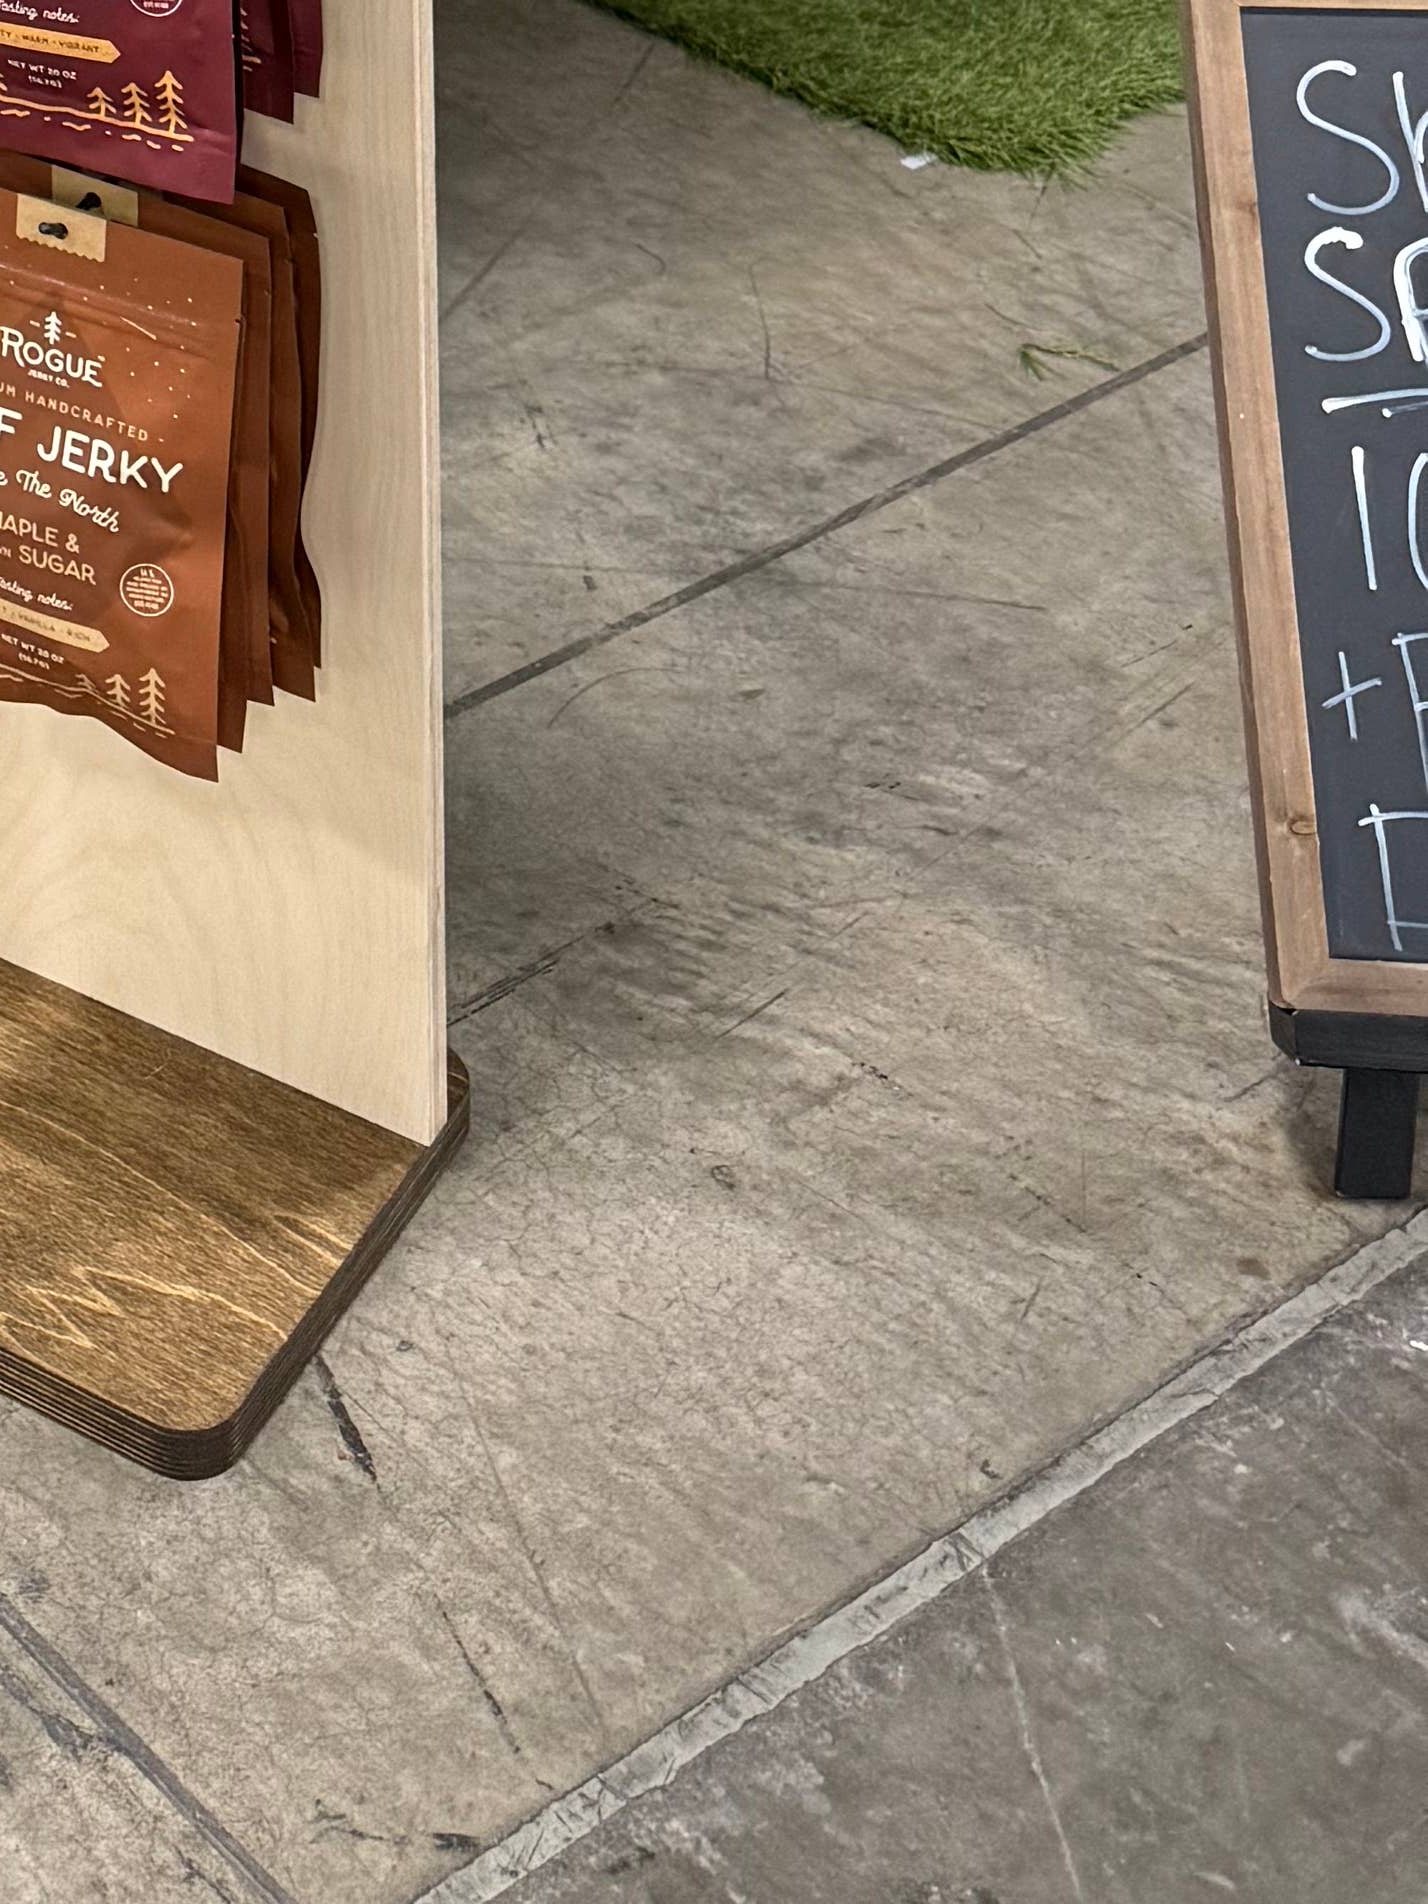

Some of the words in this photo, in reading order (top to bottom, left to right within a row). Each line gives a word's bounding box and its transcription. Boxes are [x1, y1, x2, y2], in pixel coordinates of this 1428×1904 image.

[0, 325, 104, 389] ROGUE
[24, 390, 149, 442] HANDCRAFTED
[36, 425, 184, 494] JERKY
[15, 468, 53, 500] The
[59, 488, 120, 534] North
[18, 544, 97, 587] SUGAR
[64, 532, 81, 555] &
